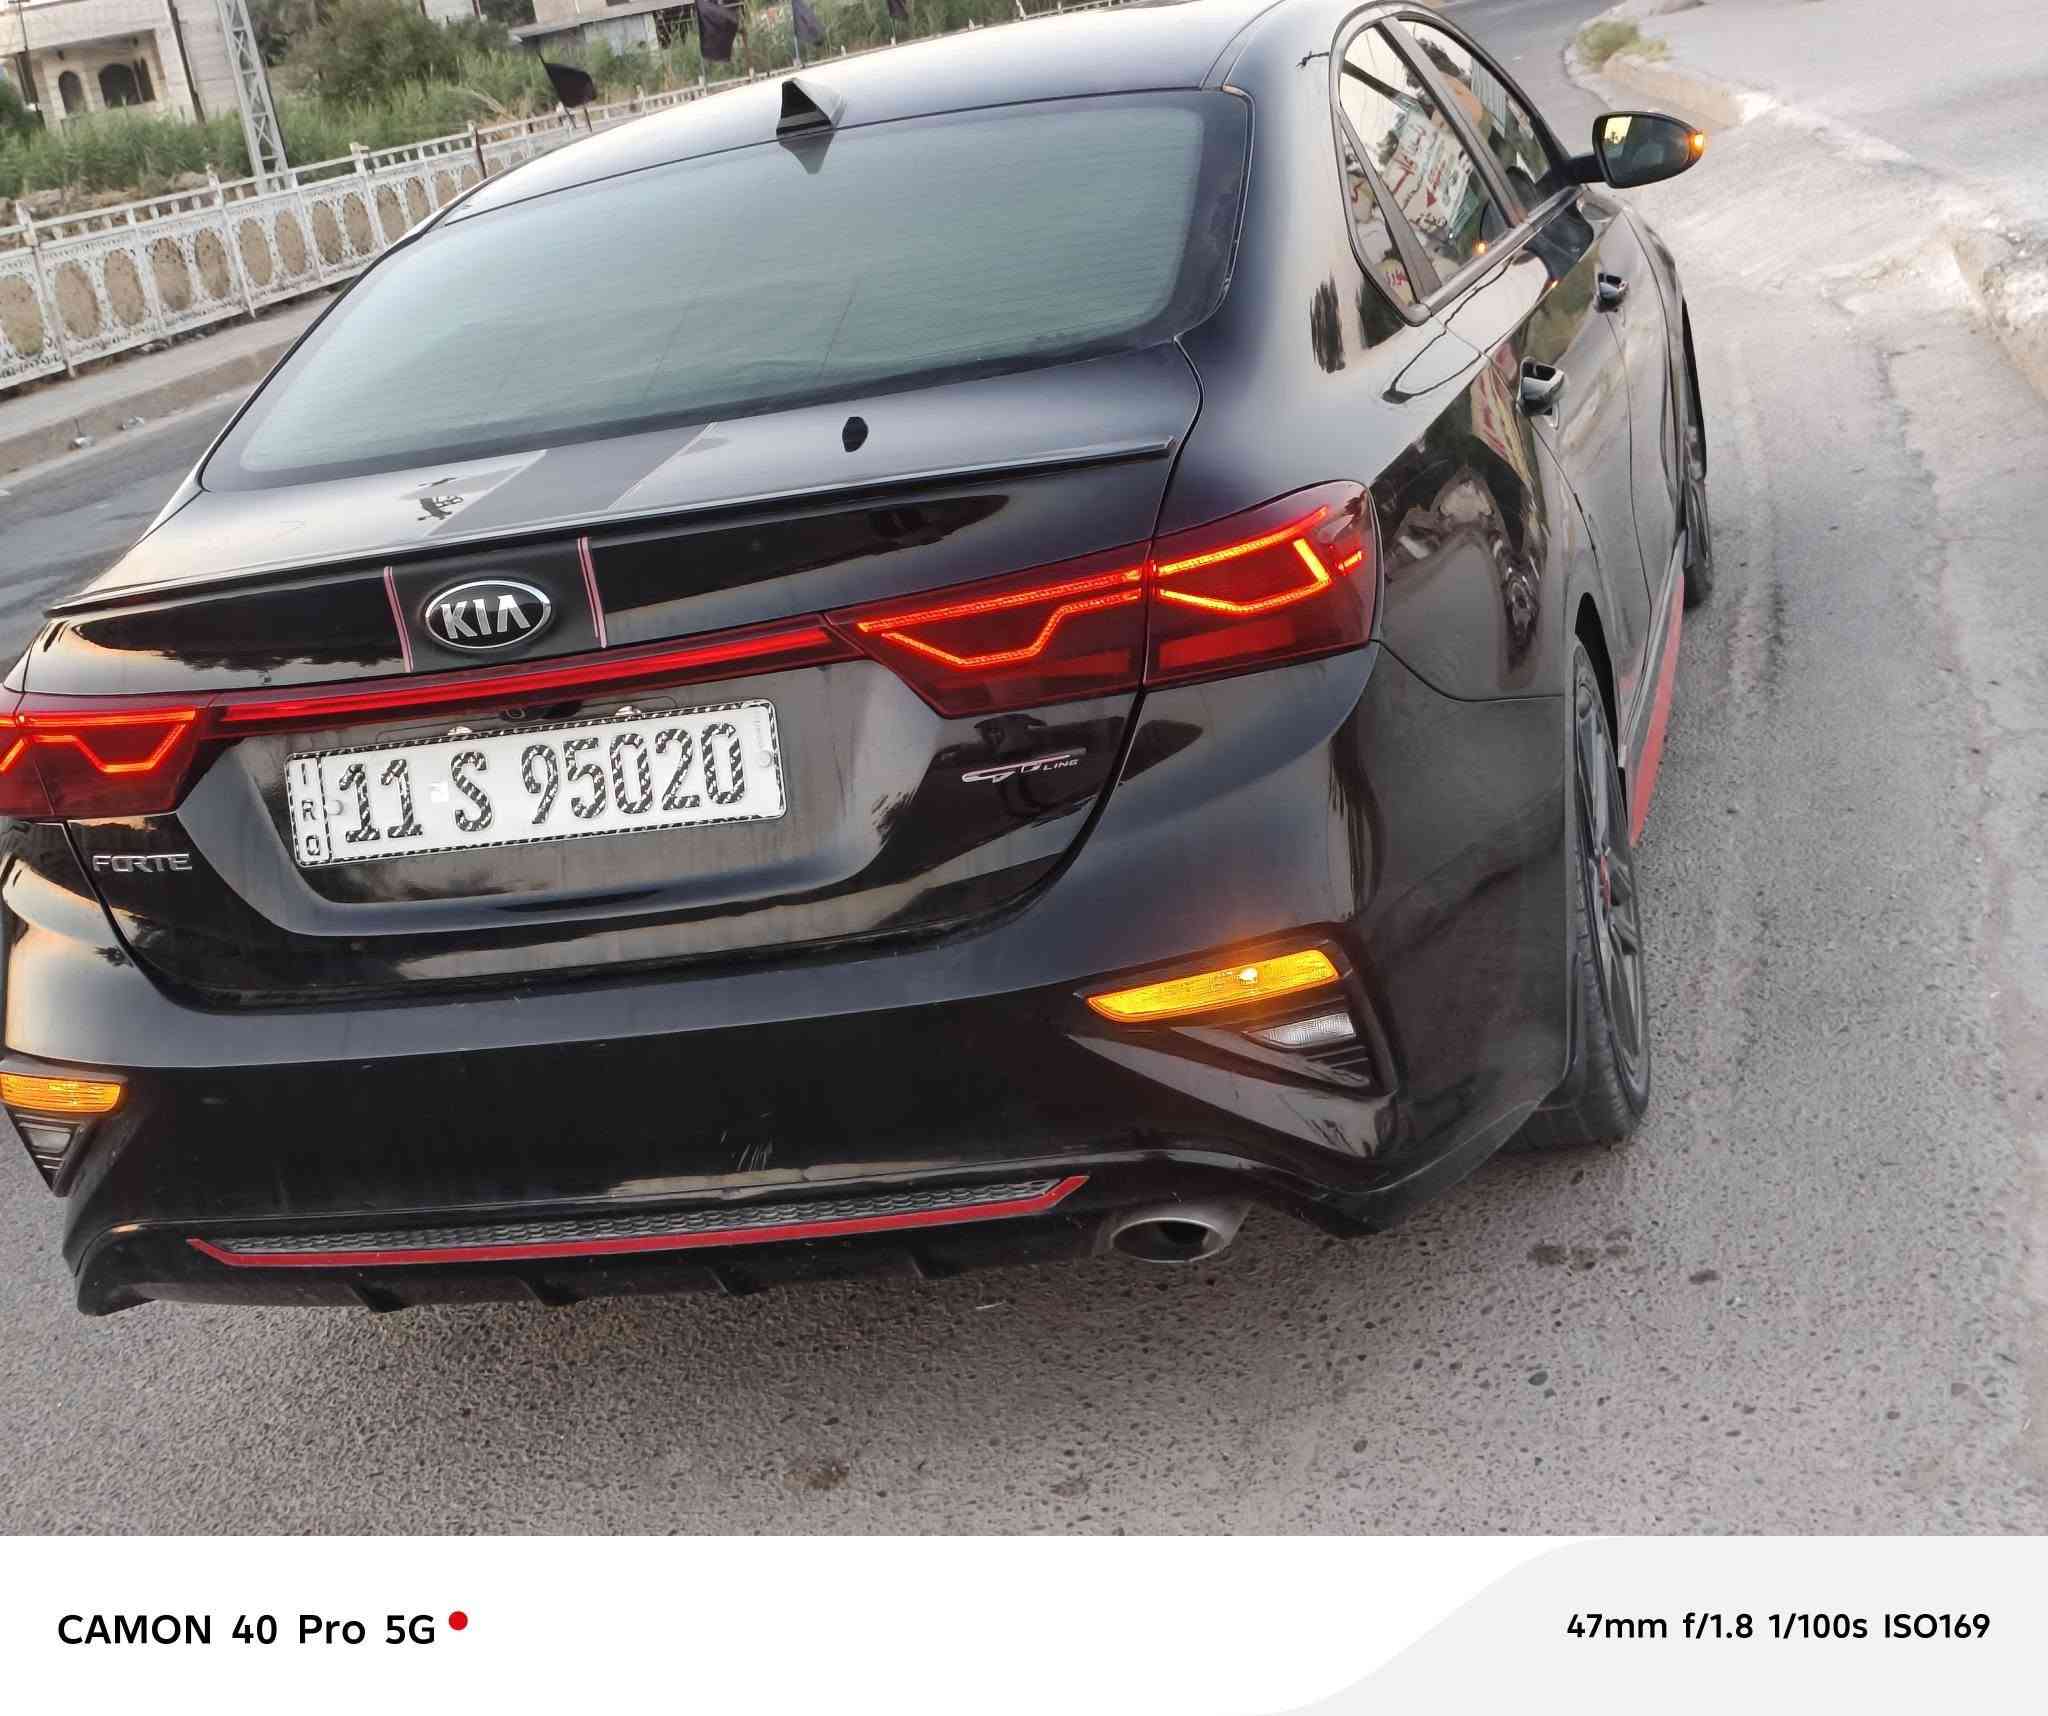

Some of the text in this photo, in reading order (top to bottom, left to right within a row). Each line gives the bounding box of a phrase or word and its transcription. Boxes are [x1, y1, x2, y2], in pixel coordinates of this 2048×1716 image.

[440, 594, 531, 639] KIA
[338, 721, 746, 843] 11 S 95020
[92, 853, 192, 872] FORTE
